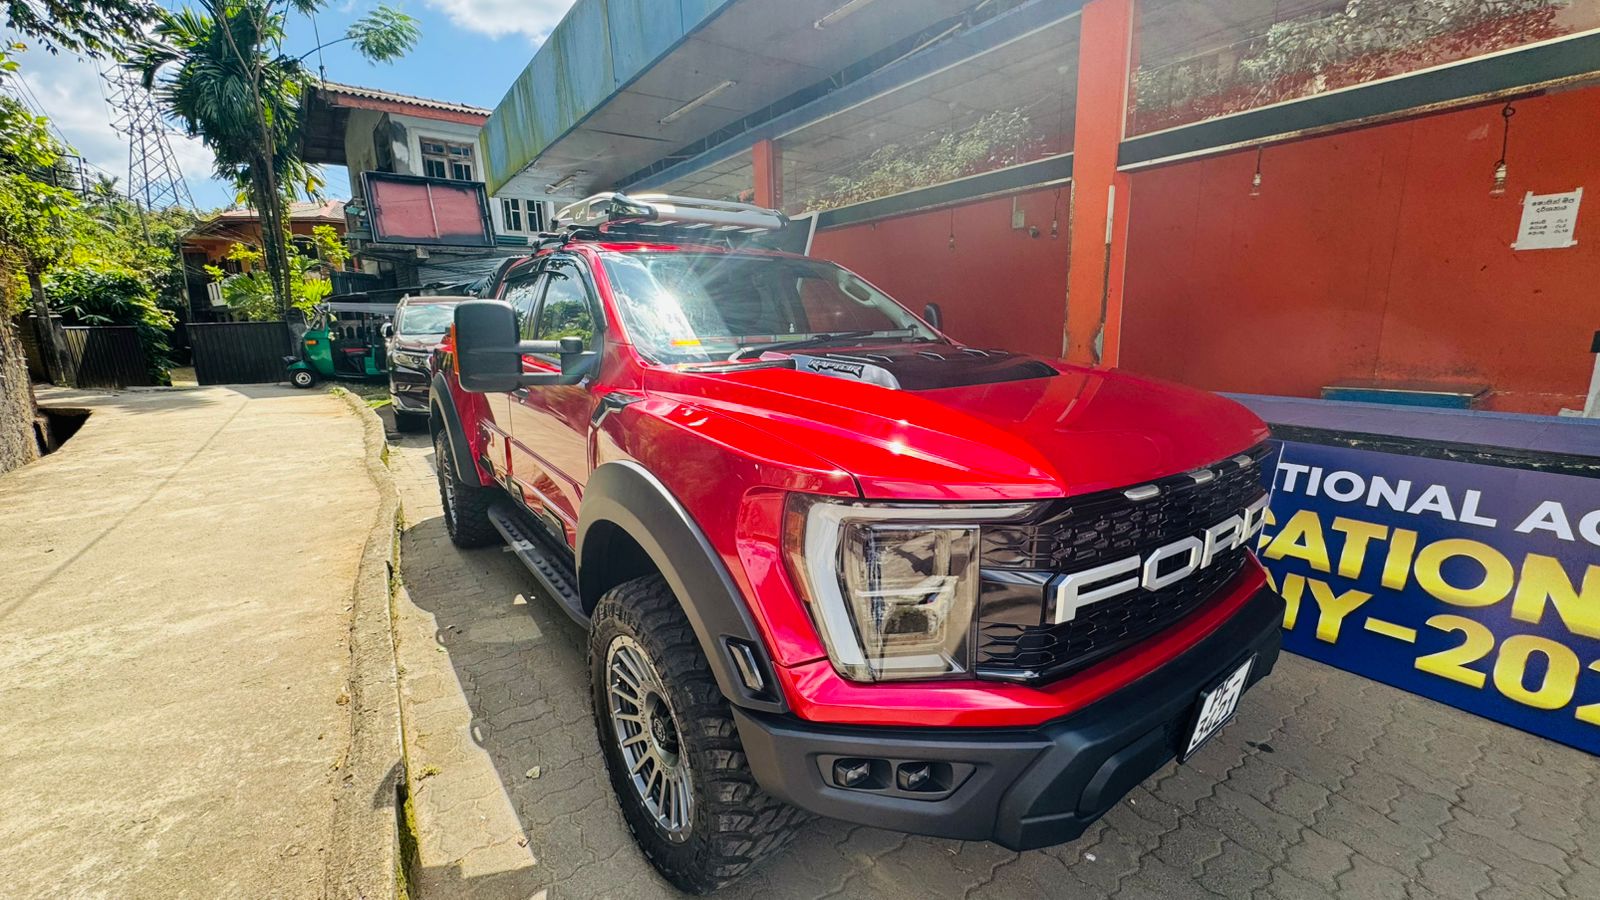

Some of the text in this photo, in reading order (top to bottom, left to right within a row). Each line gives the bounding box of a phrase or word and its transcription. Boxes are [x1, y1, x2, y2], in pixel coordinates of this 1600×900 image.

[807, 359, 864, 379] RAPTOR
[1274, 462, 1497, 528] TIONAL
[1055, 493, 1268, 625] FORD
